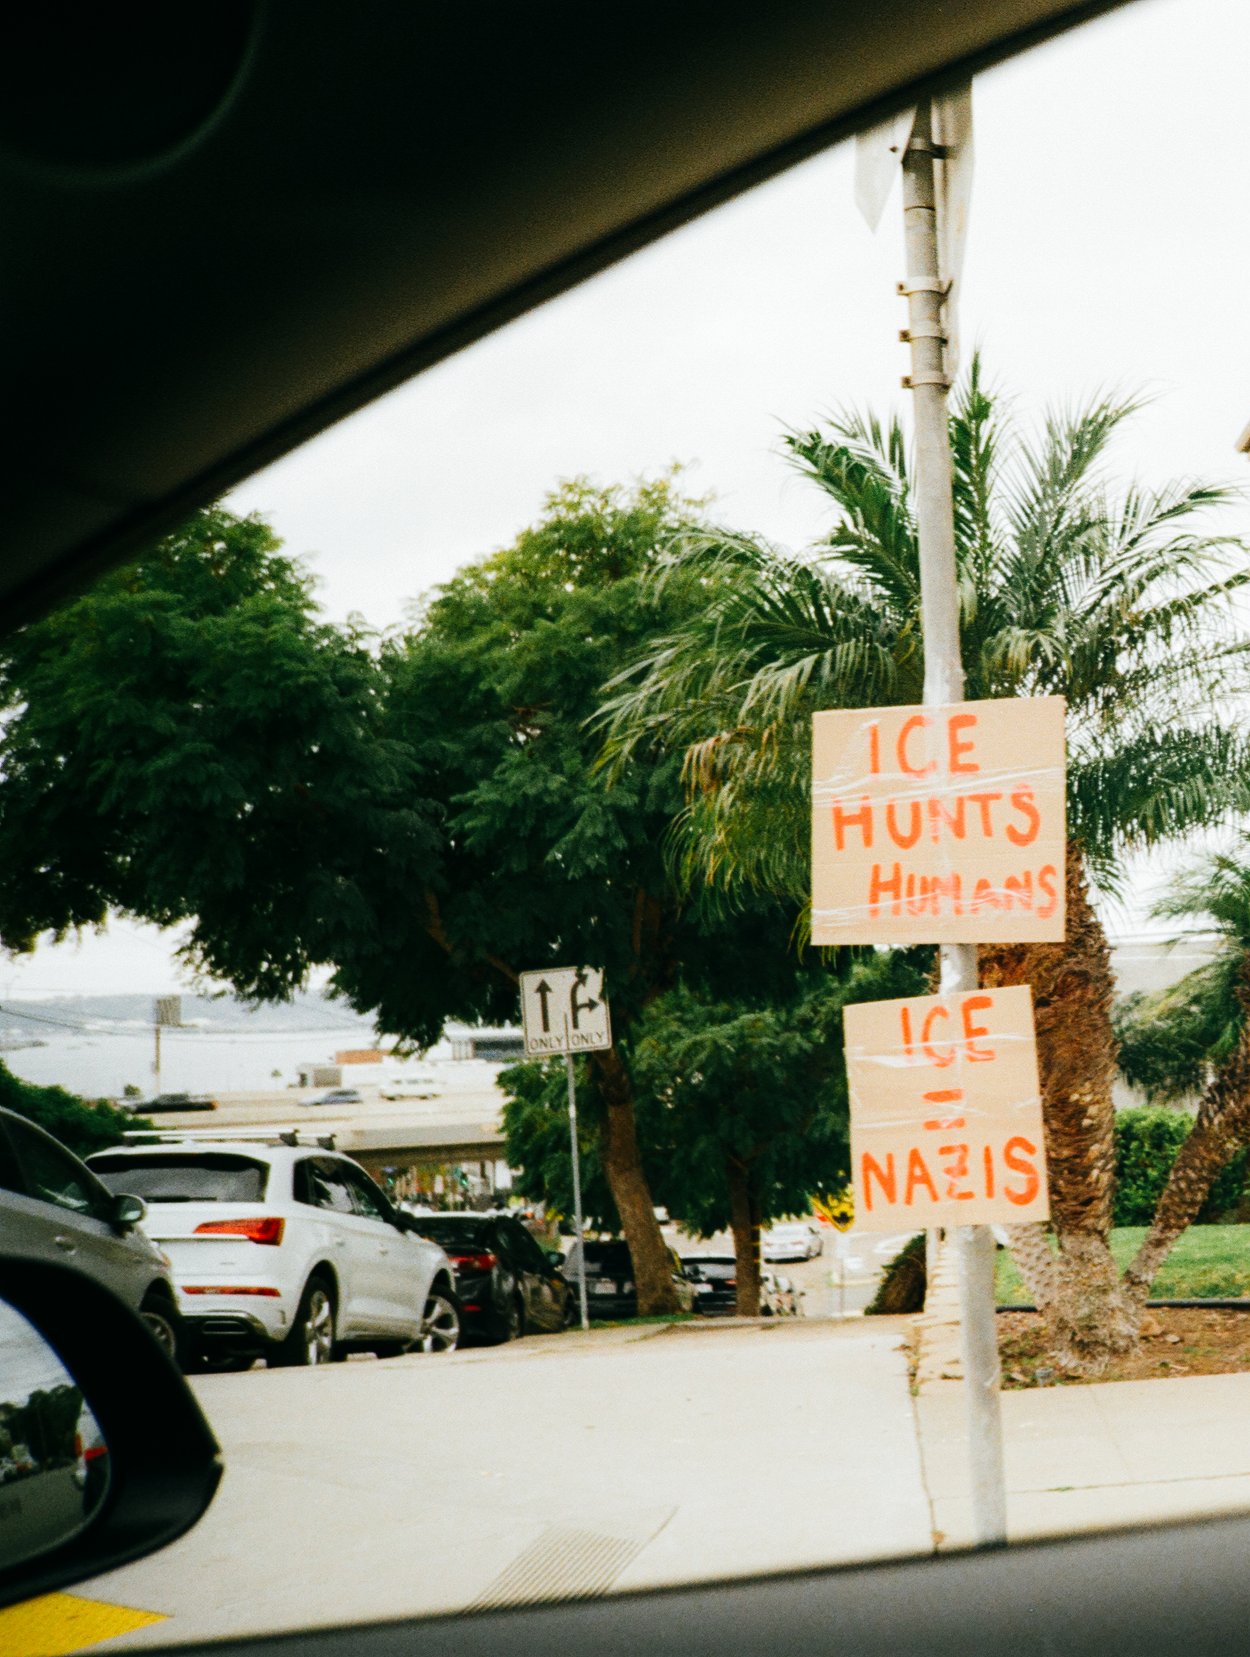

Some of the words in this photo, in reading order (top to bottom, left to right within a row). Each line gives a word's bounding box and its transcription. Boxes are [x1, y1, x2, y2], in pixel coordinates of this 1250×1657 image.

[868, 713, 981, 776] ICE
[832, 783, 1041, 851] HUNTS
[869, 862, 1058, 918] HUMANS
[530, 1036, 563, 1049] ONLY
[571, 1031, 604, 1045] ONLY
[900, 996, 997, 1068] ICE
[862, 1136, 1040, 1211] NAZIS
